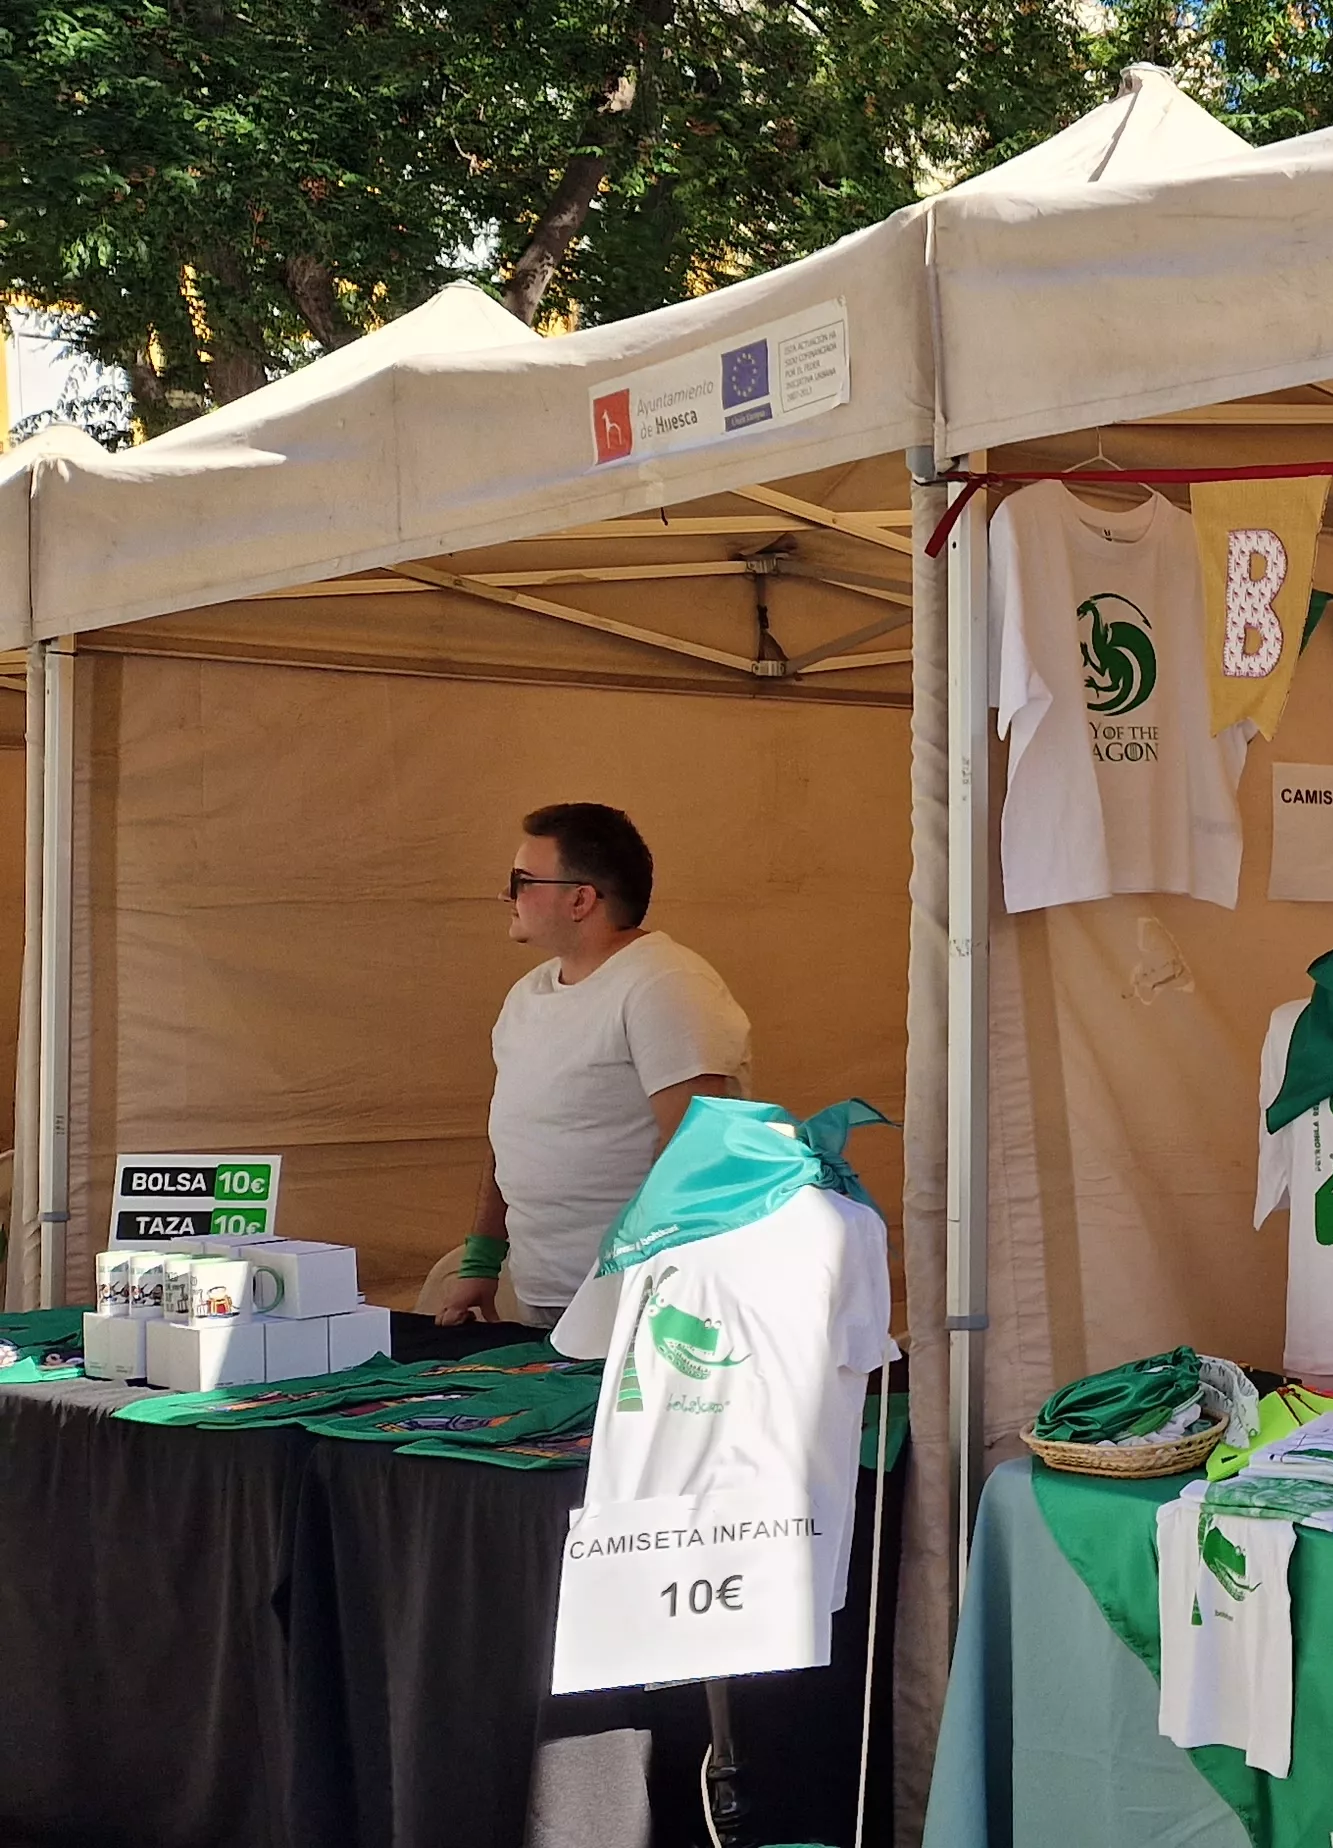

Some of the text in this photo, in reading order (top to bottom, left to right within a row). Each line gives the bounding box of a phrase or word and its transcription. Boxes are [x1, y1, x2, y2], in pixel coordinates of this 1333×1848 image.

[637, 380, 714, 419] Ayuntamiento
[640, 409, 698, 440] de Huesca
[1103, 726, 1124, 740] OF
[1128, 726, 1159, 740] THE
[131, 1170, 265, 1194] BOLSA 10€
[136, 1214, 261, 1235] TAZA 10€
[570, 1518, 822, 1560] CAMISETA INFANTIL
[660, 1574, 744, 1618] 10€
